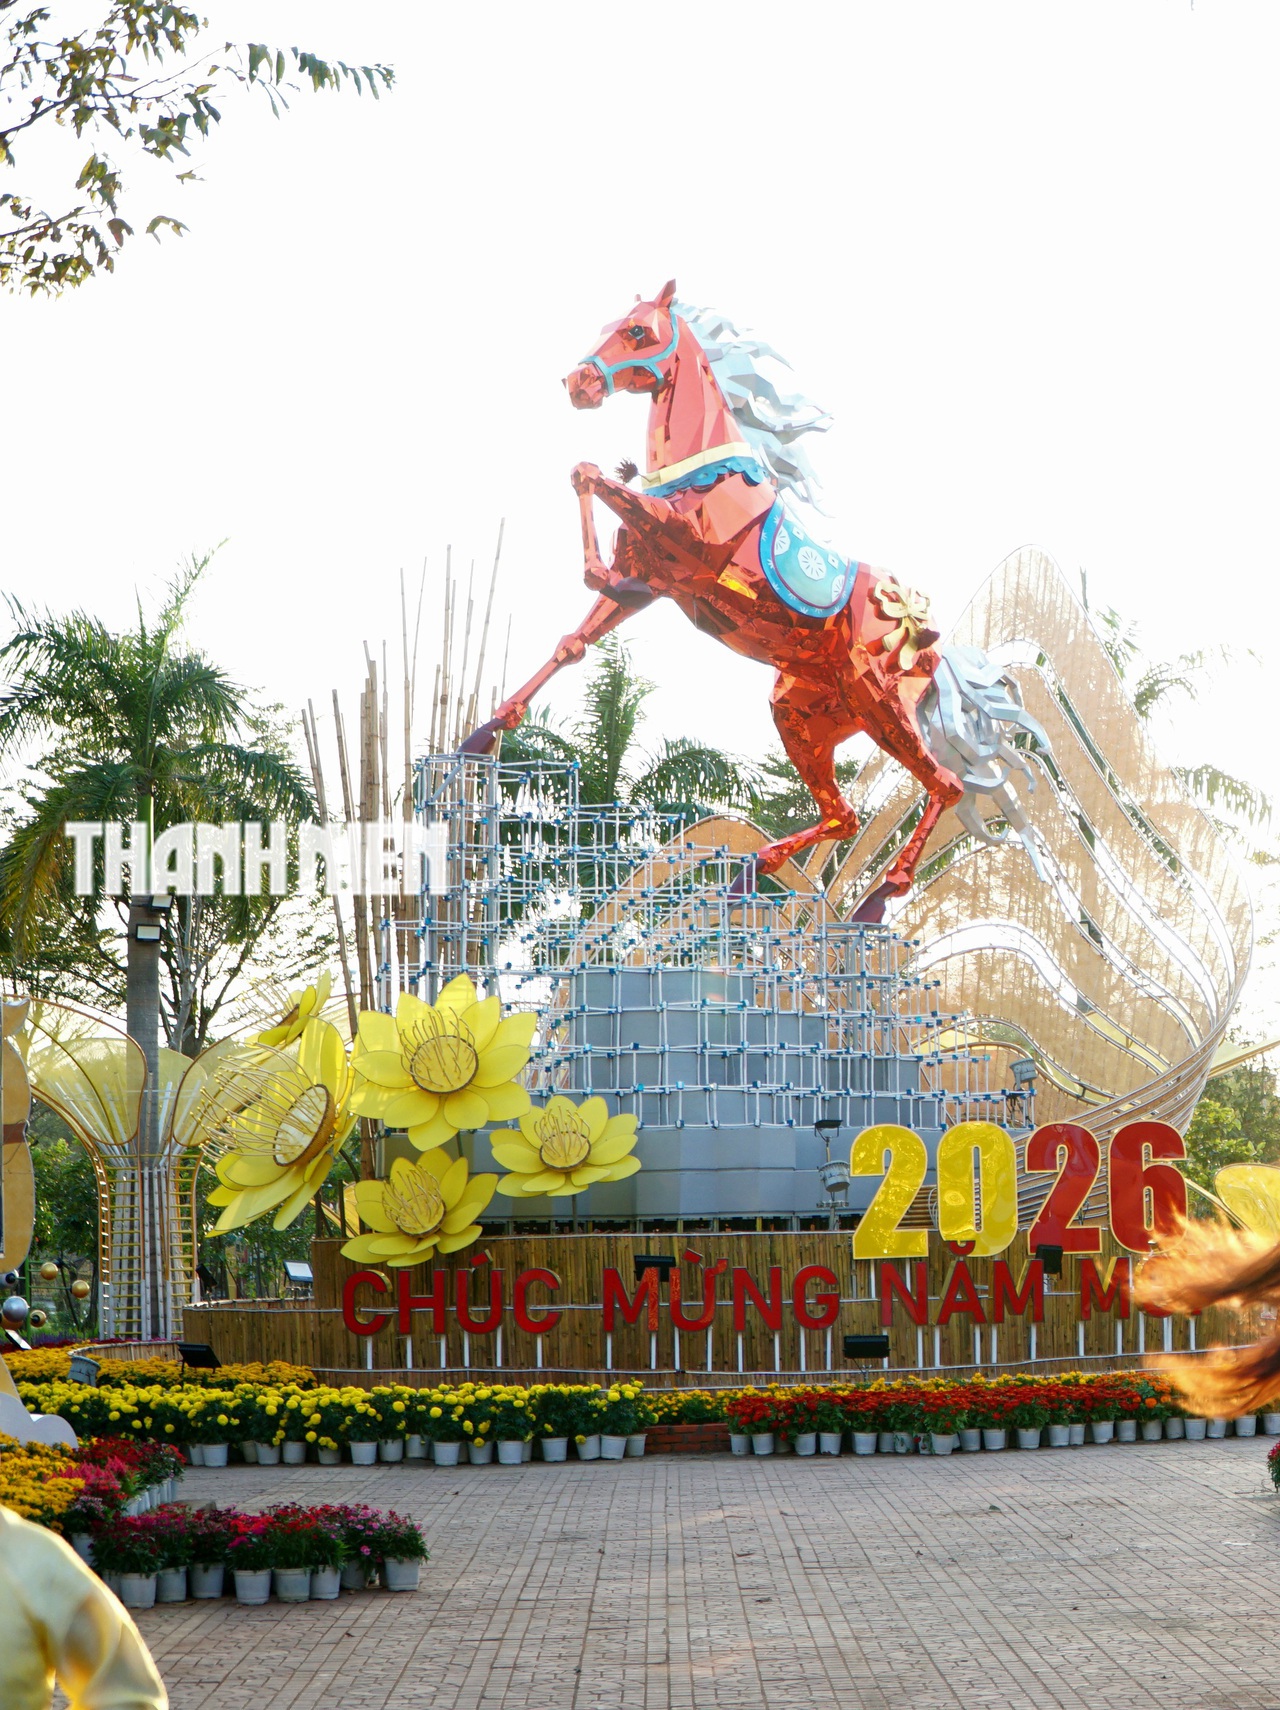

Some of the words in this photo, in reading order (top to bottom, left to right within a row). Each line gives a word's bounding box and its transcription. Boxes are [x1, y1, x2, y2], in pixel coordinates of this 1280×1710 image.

[850, 1120, 1189, 1260] 2026
[342, 1249, 563, 1336] CHÚC
[603, 1248, 840, 1332] MỪNG
[880, 1240, 1044, 1327] NĂM
